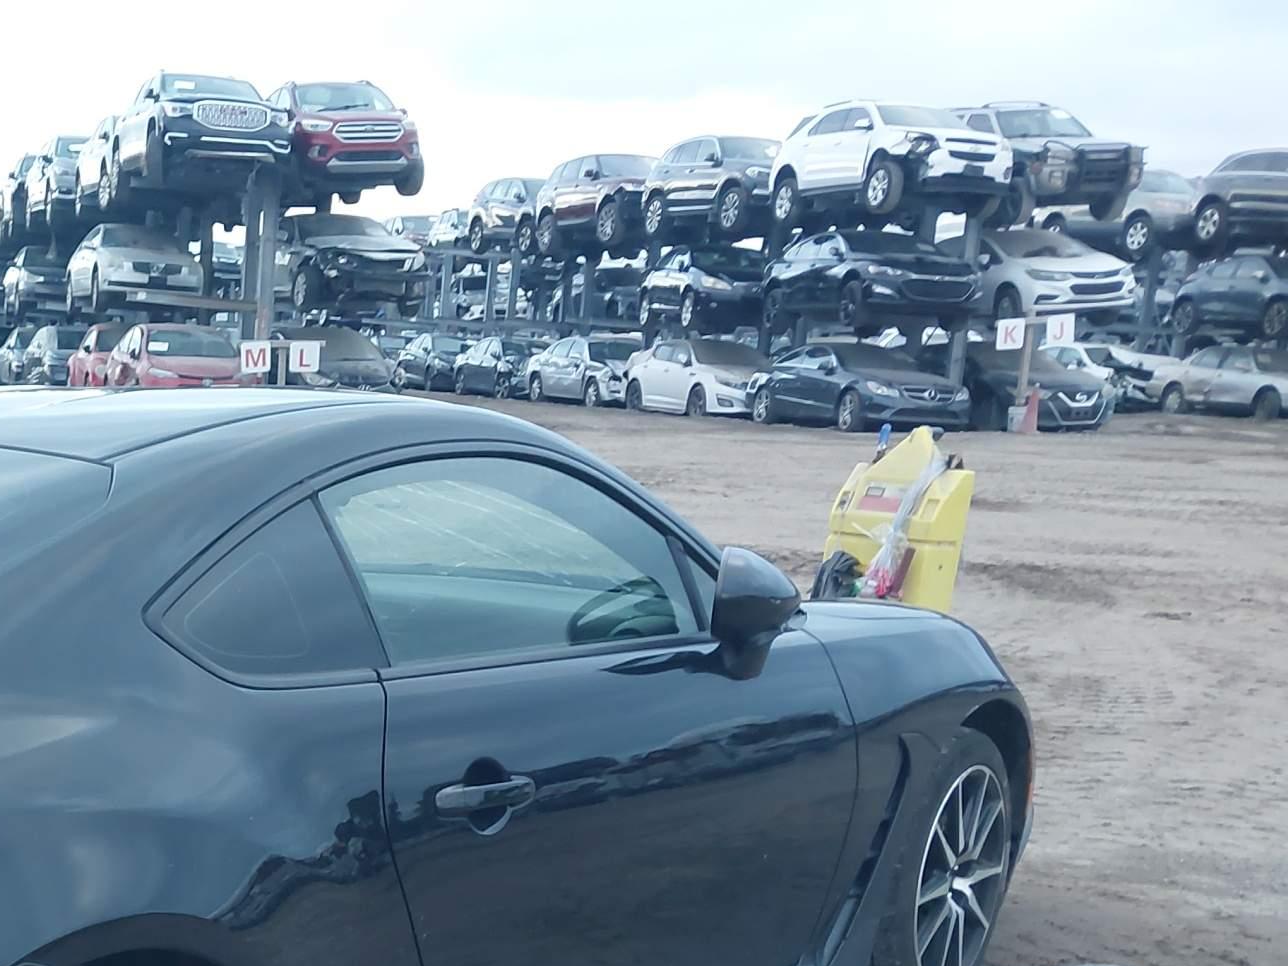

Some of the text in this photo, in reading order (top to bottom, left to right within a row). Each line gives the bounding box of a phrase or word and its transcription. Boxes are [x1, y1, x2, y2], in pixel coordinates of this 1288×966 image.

[1003, 325, 1017, 345] K
[1053, 321, 1065, 341] J
[245, 347, 267, 369] M
[299, 348, 312, 368] L
